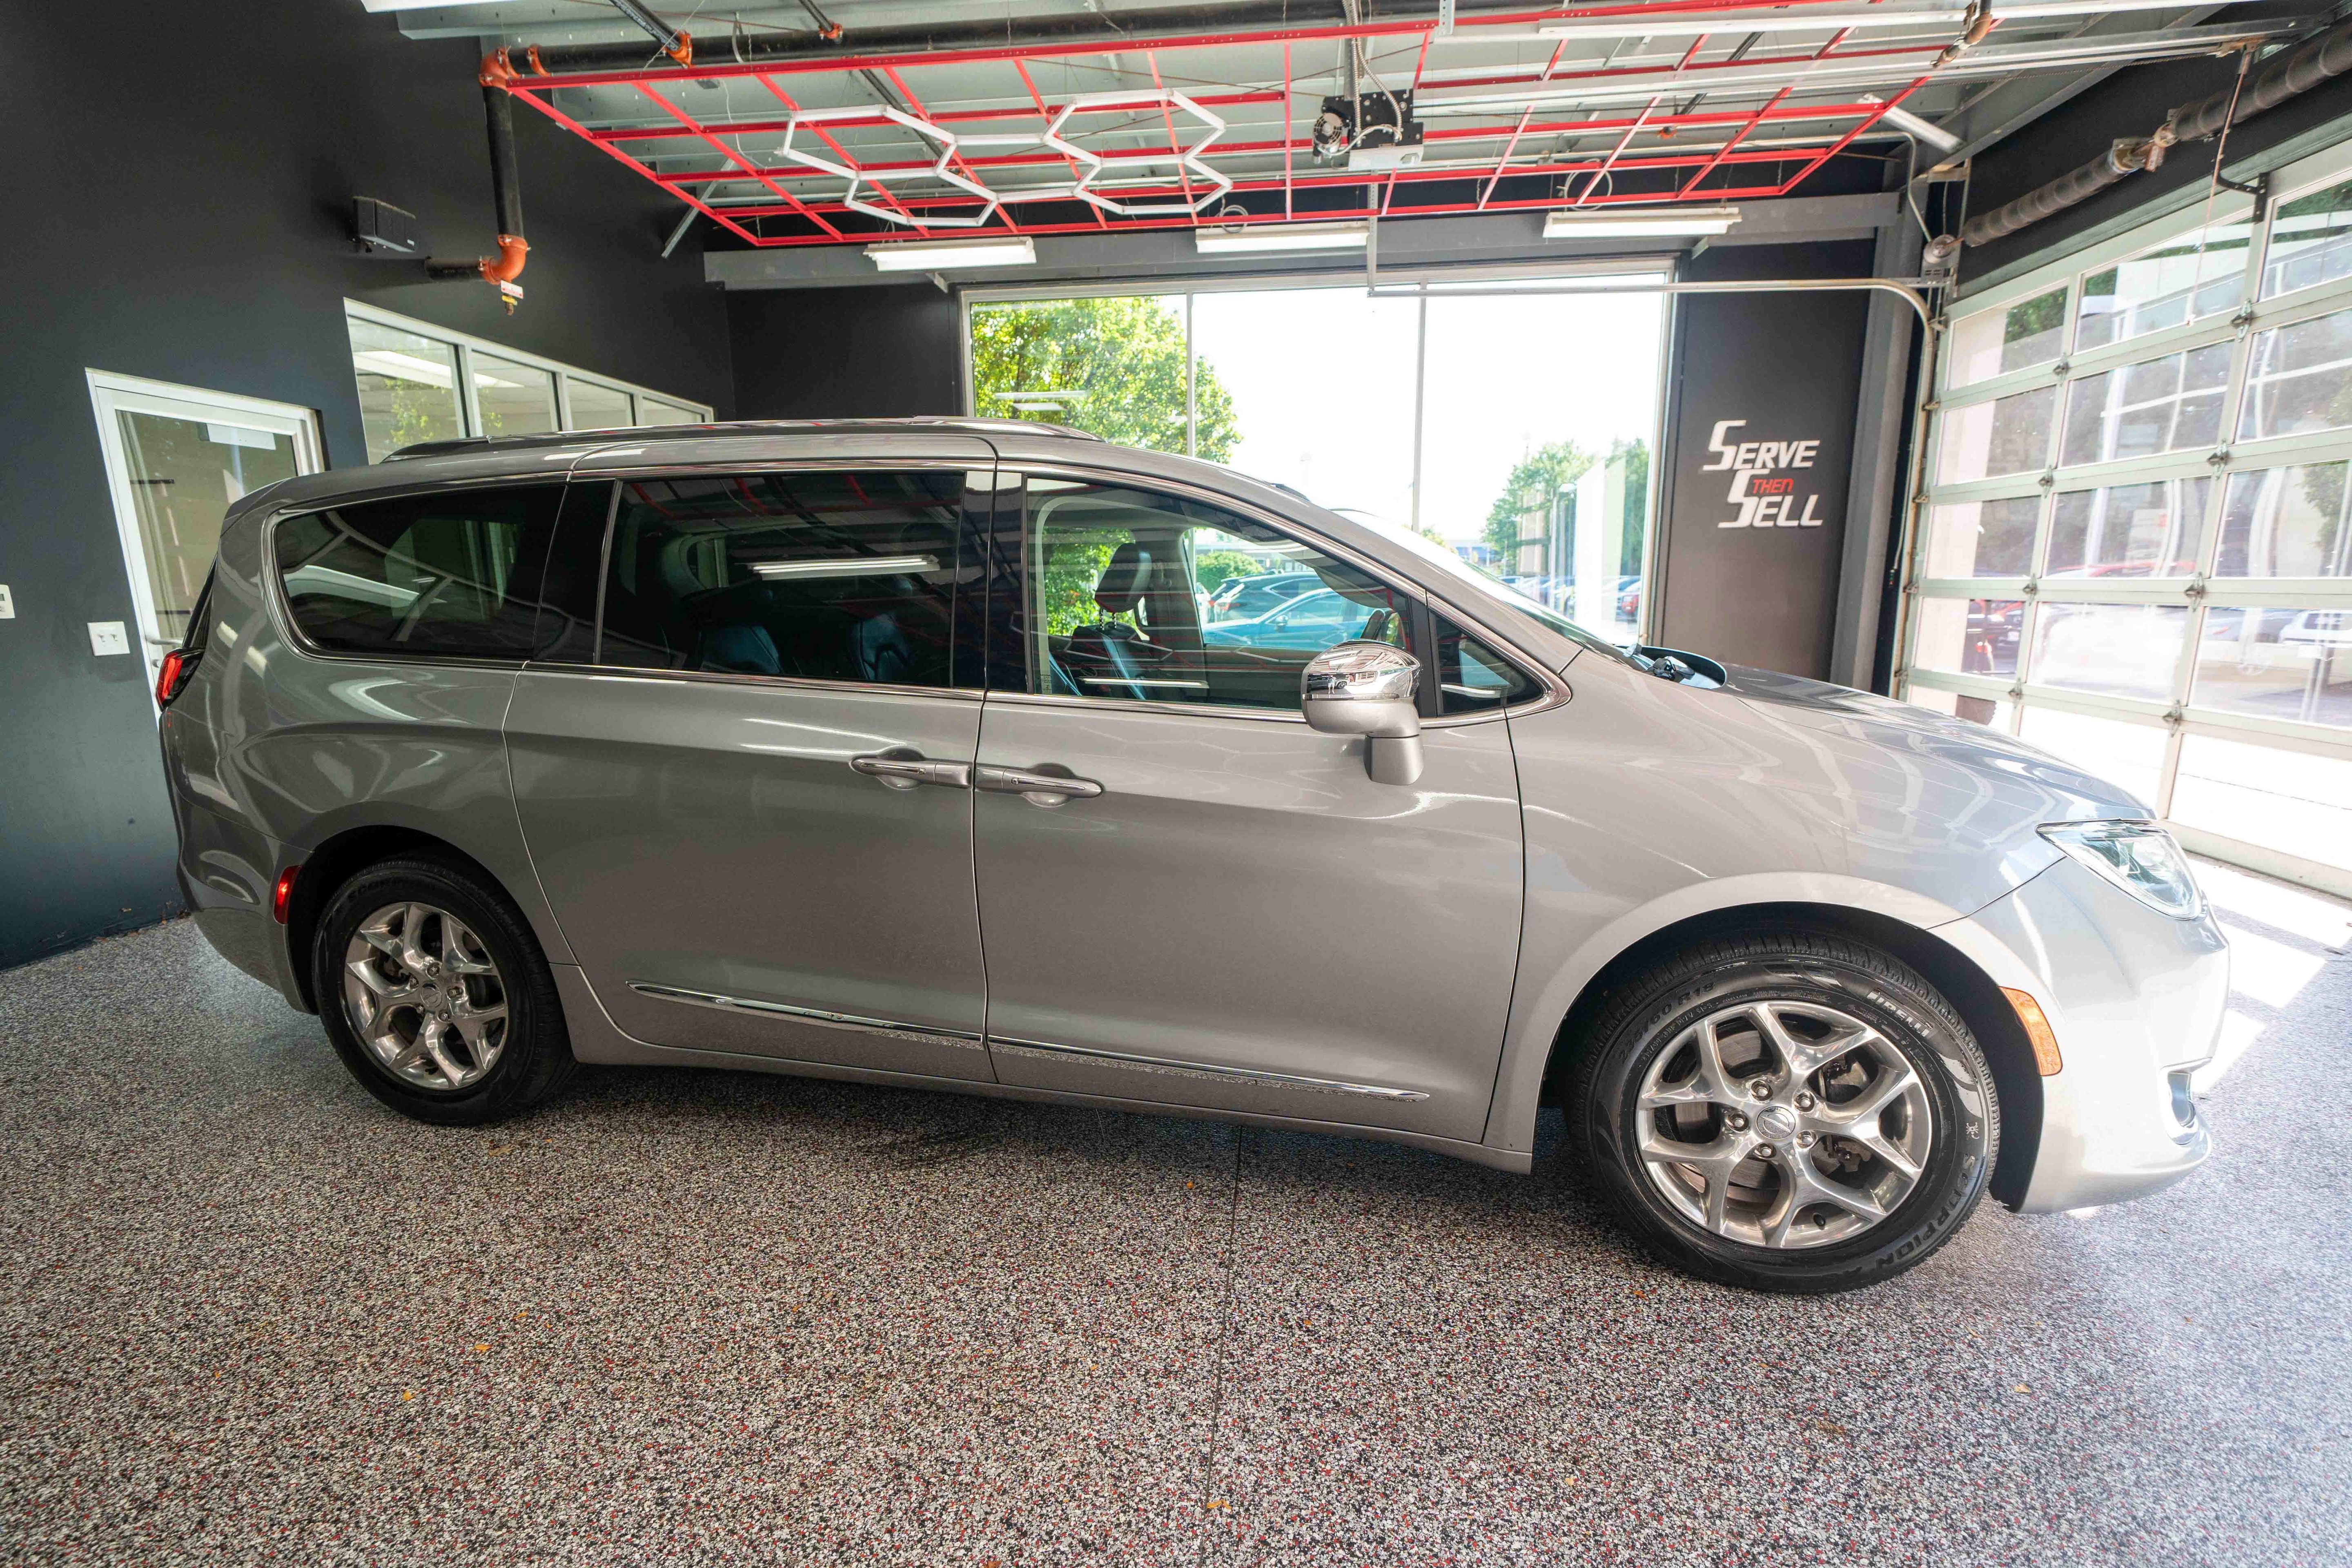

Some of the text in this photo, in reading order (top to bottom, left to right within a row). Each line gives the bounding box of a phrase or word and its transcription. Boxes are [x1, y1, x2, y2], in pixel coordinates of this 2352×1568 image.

[1703, 420, 1820, 470] SERVE
[1717, 468, 1823, 528] SELL
[1752, 478, 1794, 494] THEN
[1866, 988, 1933, 1038] PIRELLI
[1876, 1152, 1976, 1268] SCORPION
